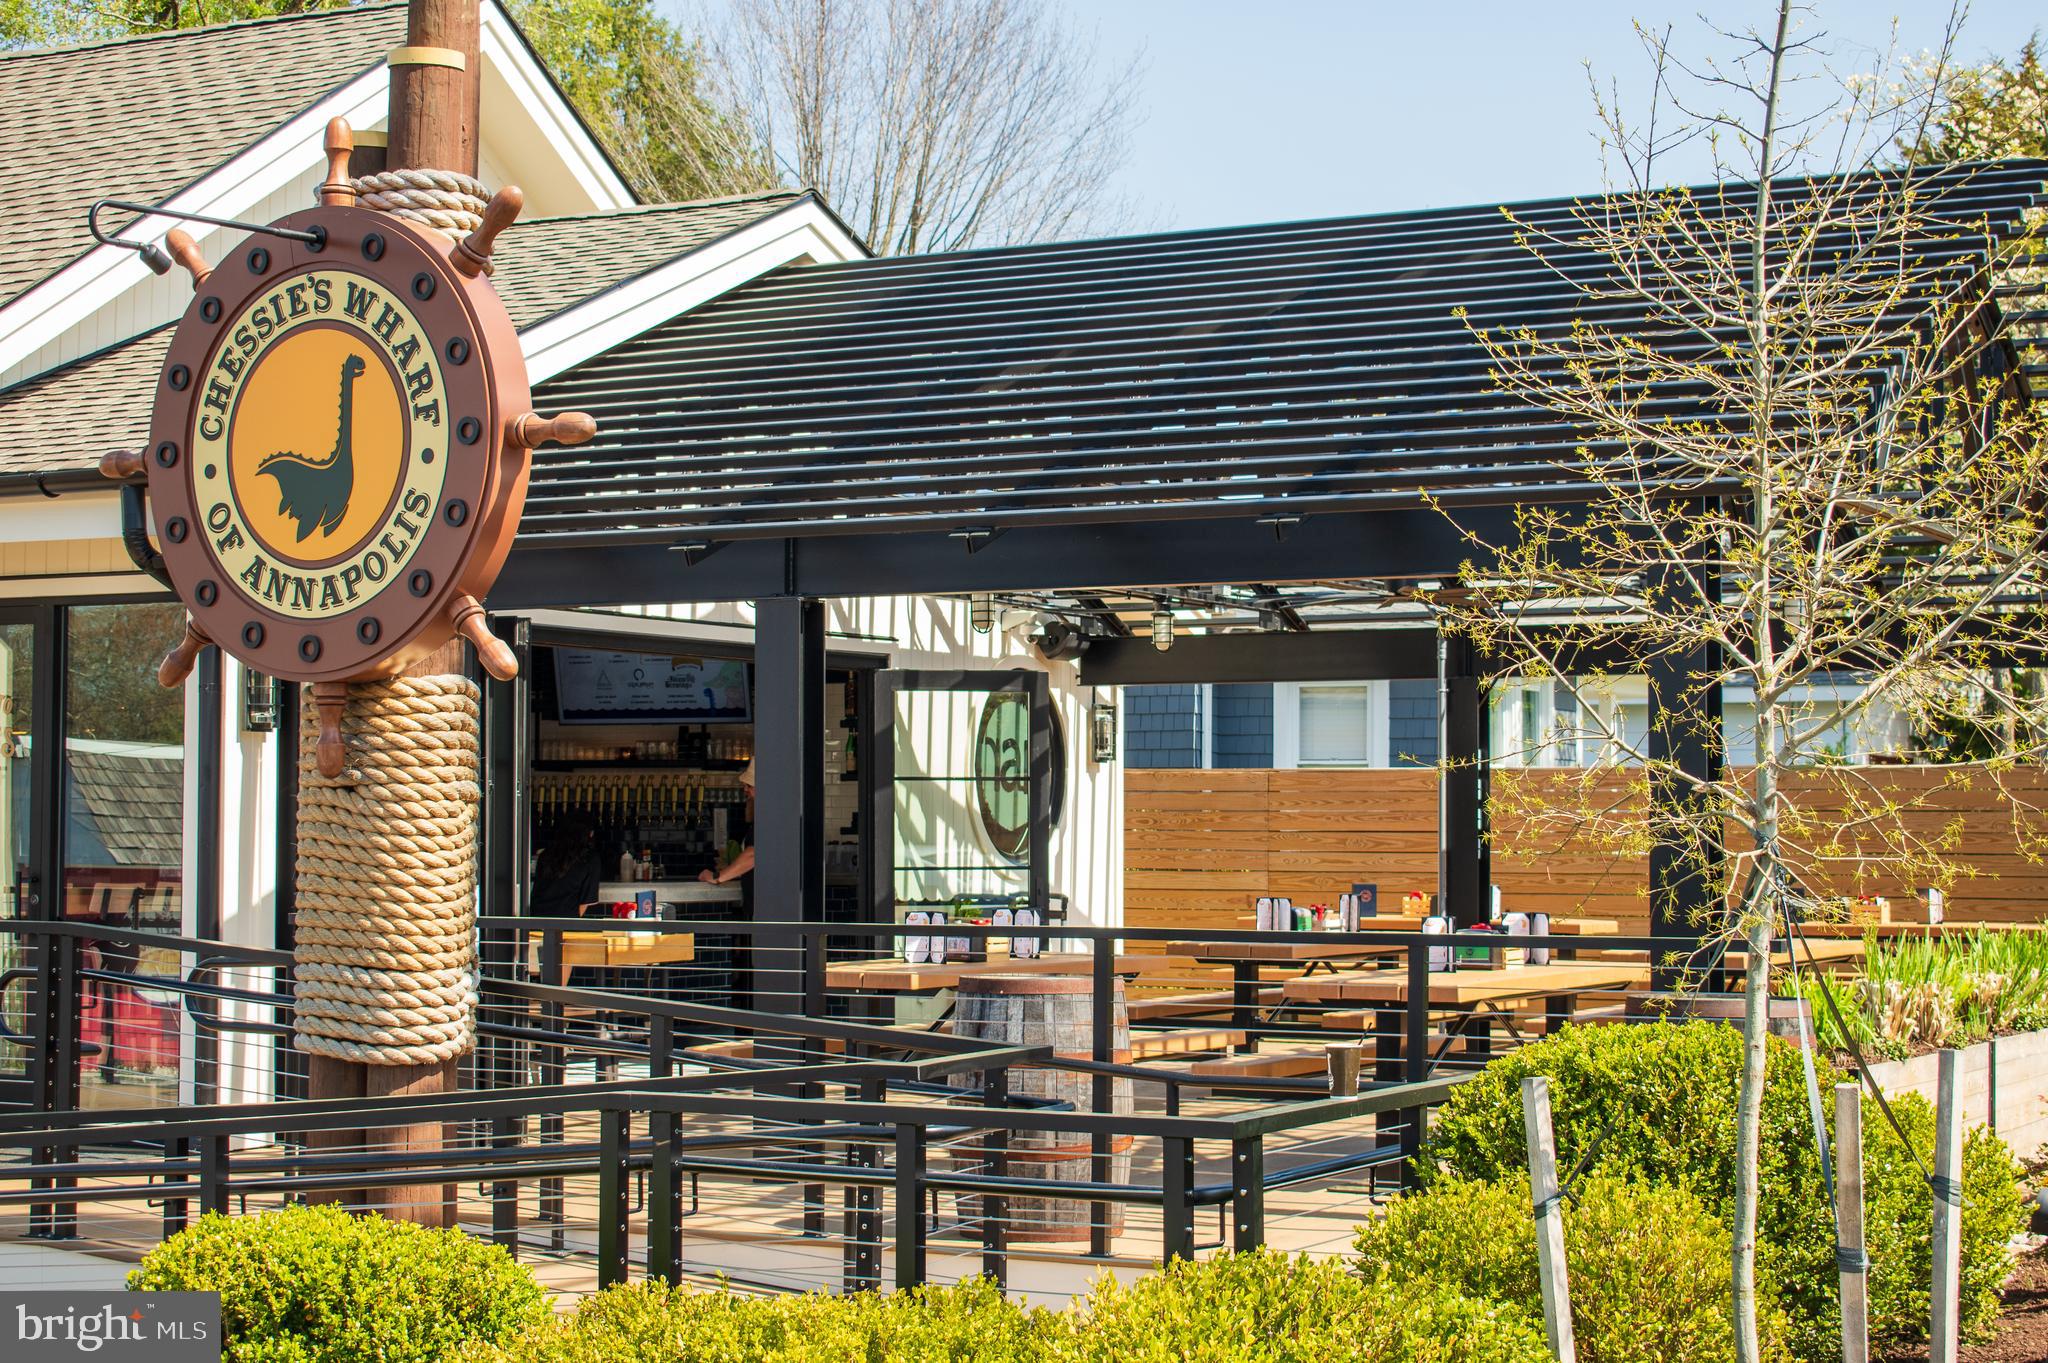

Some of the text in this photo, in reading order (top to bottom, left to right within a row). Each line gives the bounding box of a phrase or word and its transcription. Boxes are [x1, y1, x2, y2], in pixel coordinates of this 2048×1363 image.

[200, 273, 442, 442] CHESSIE'S WHARF
[207, 488, 431, 612] OF ANNAPOLIS
